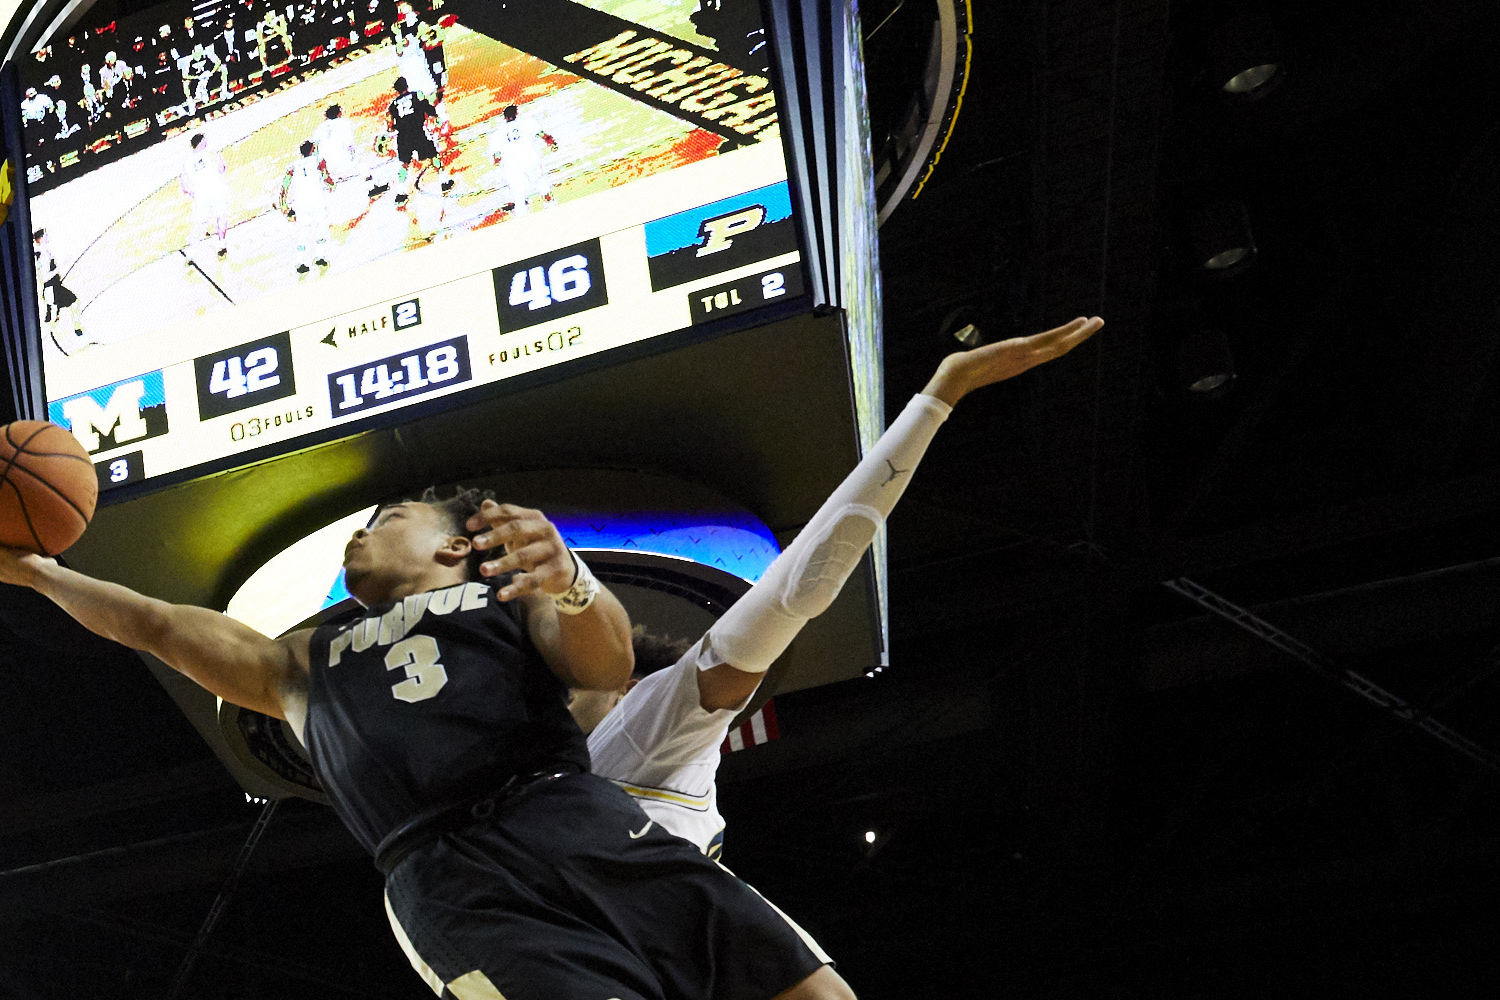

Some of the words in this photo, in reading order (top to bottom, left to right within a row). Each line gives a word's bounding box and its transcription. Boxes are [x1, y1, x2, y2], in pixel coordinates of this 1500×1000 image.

[508, 253, 591, 310] 46
[761, 274, 786, 300] 2
[348, 317, 388, 338] HALF
[396, 301, 418, 327] 2
[209, 346, 281, 399] 42
[489, 340, 544, 366] FOULS
[336, 345, 459, 410] 14:18
[63, 380, 148, 453] M
[264, 405, 314, 431] FOULS
[108, 458, 130, 483] 3
[384, 634, 449, 704] 3
